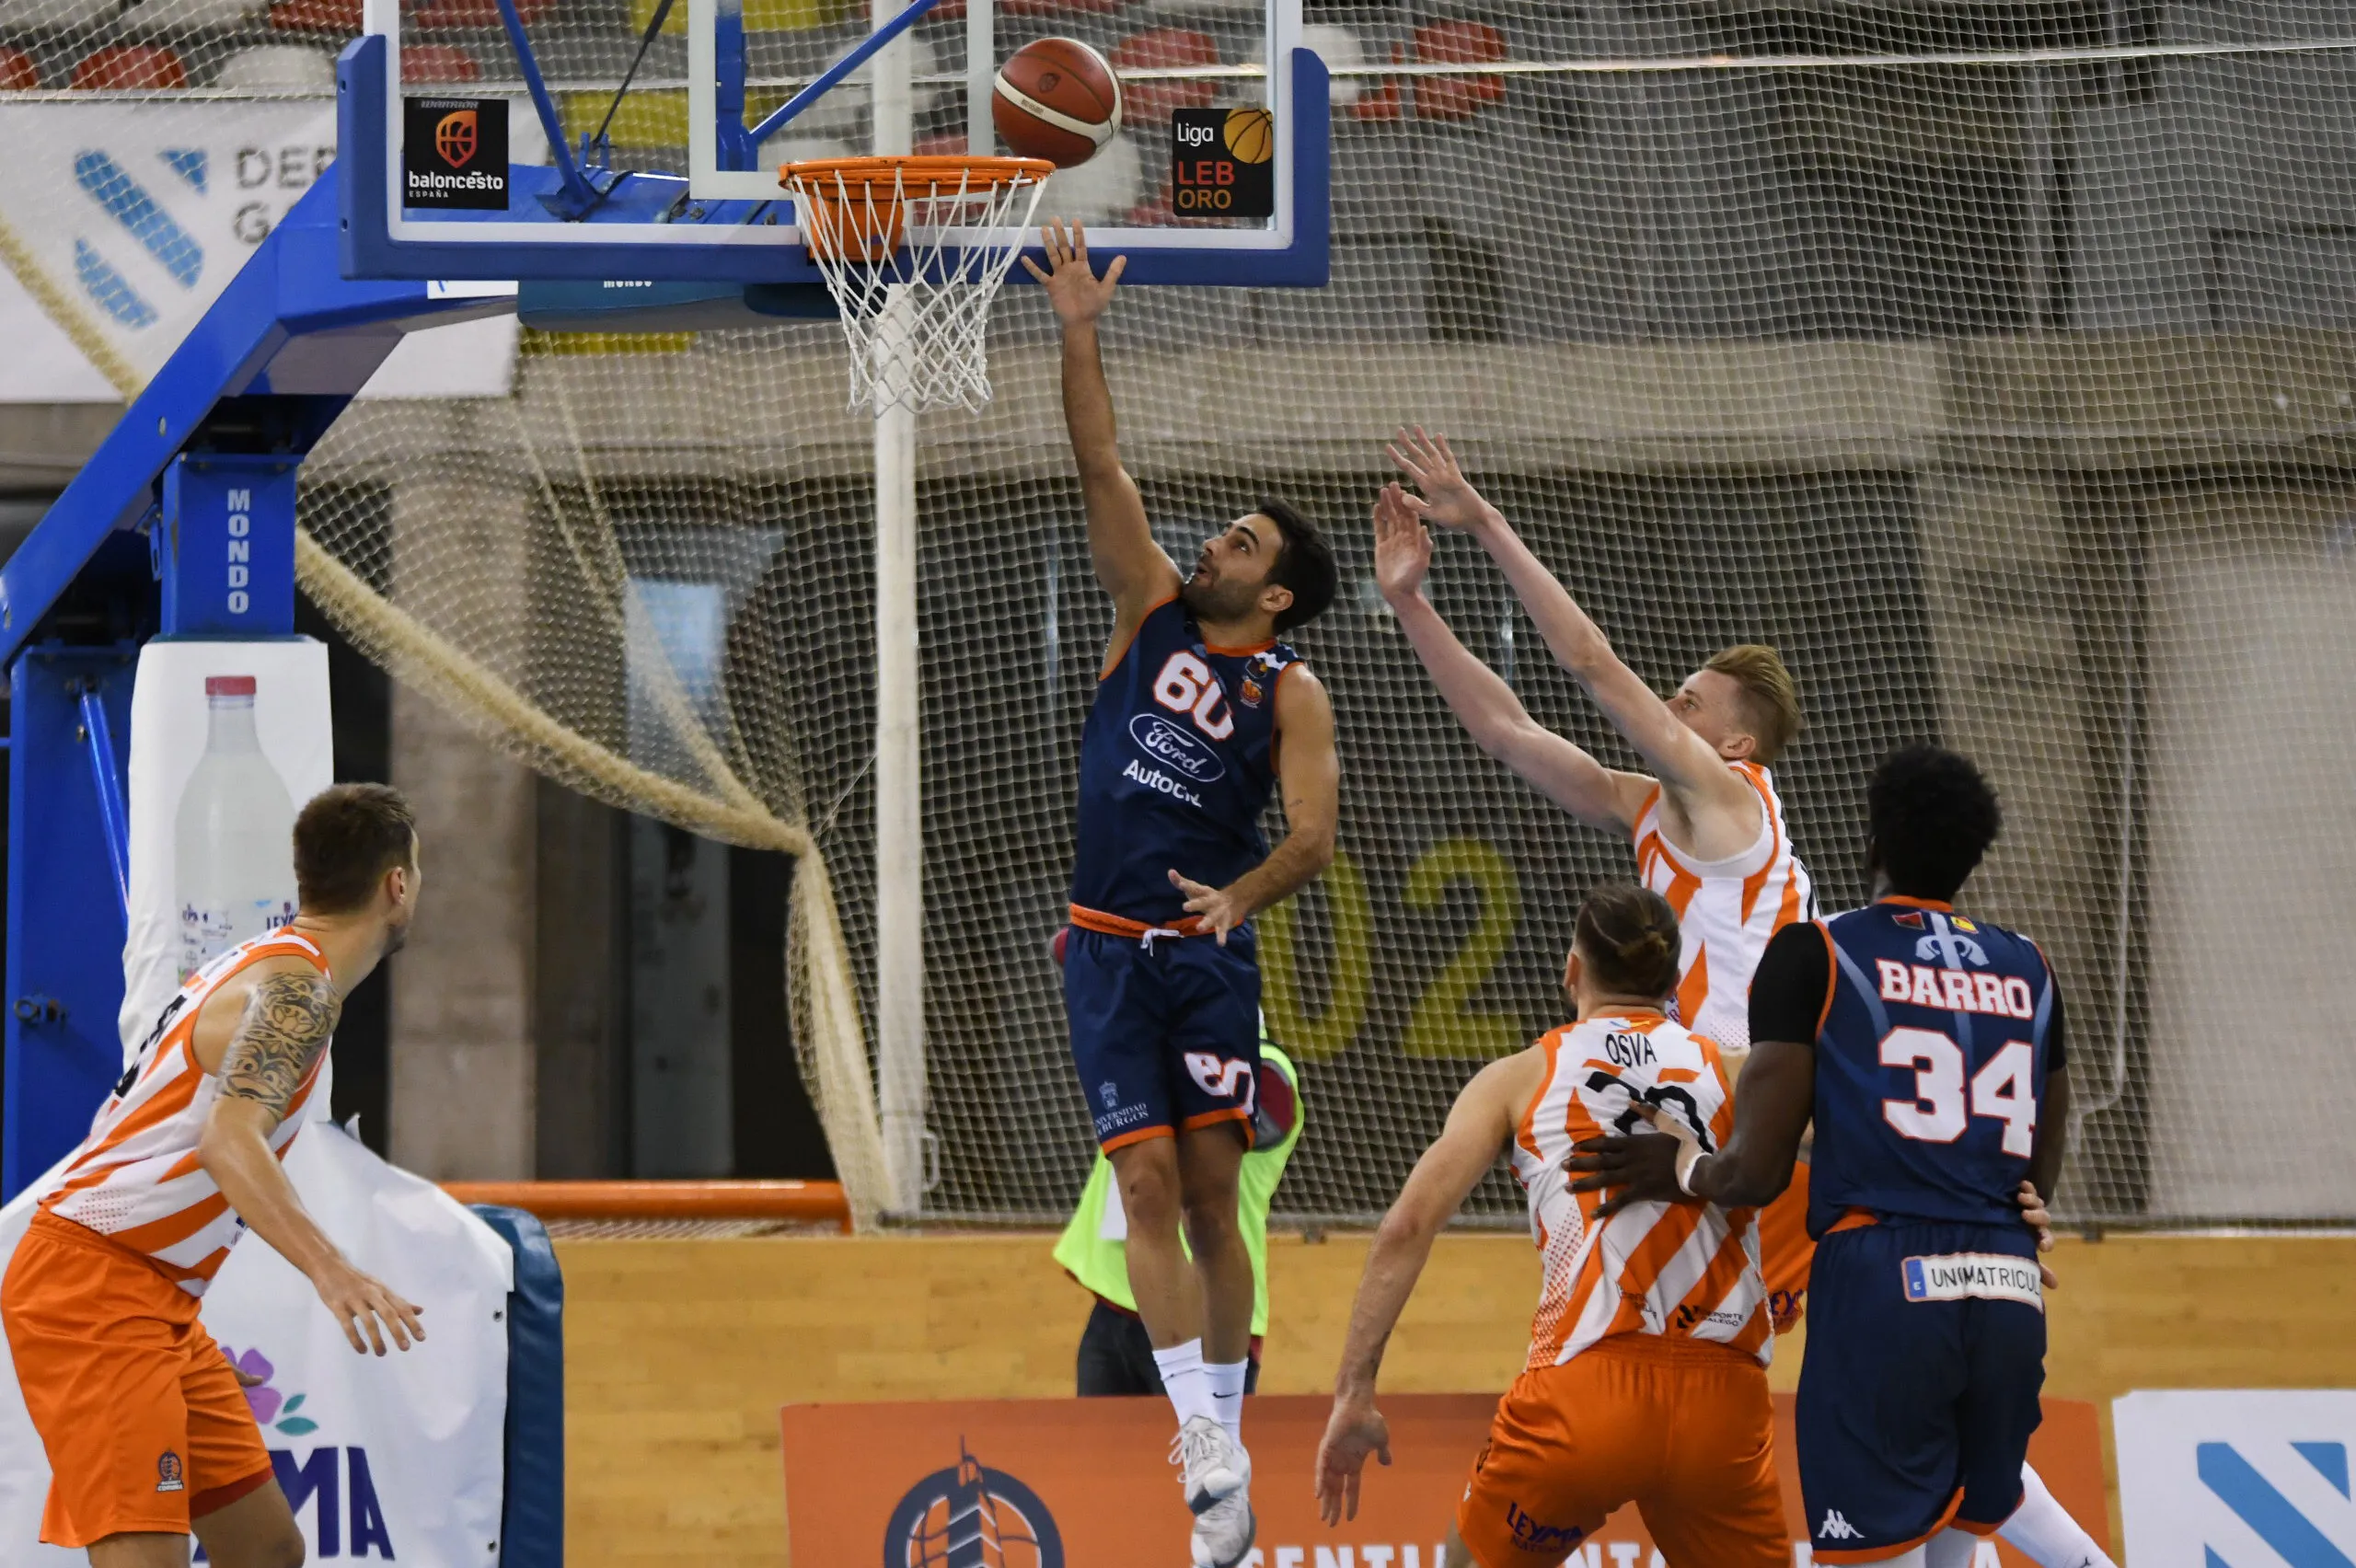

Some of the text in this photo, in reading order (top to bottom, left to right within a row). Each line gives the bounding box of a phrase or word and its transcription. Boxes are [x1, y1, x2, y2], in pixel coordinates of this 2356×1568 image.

[1177, 122, 1214, 147] Liga
[1178, 160, 1235, 186] LEB
[409, 190, 449, 198] ESPAÑA
[1178, 189, 1232, 210] ORO
[227, 486, 250, 615] MONDO
[1145, 721, 1207, 774] Ford
[1875, 958, 2034, 1021] BARRO
[1878, 1026, 2038, 1159] 34
